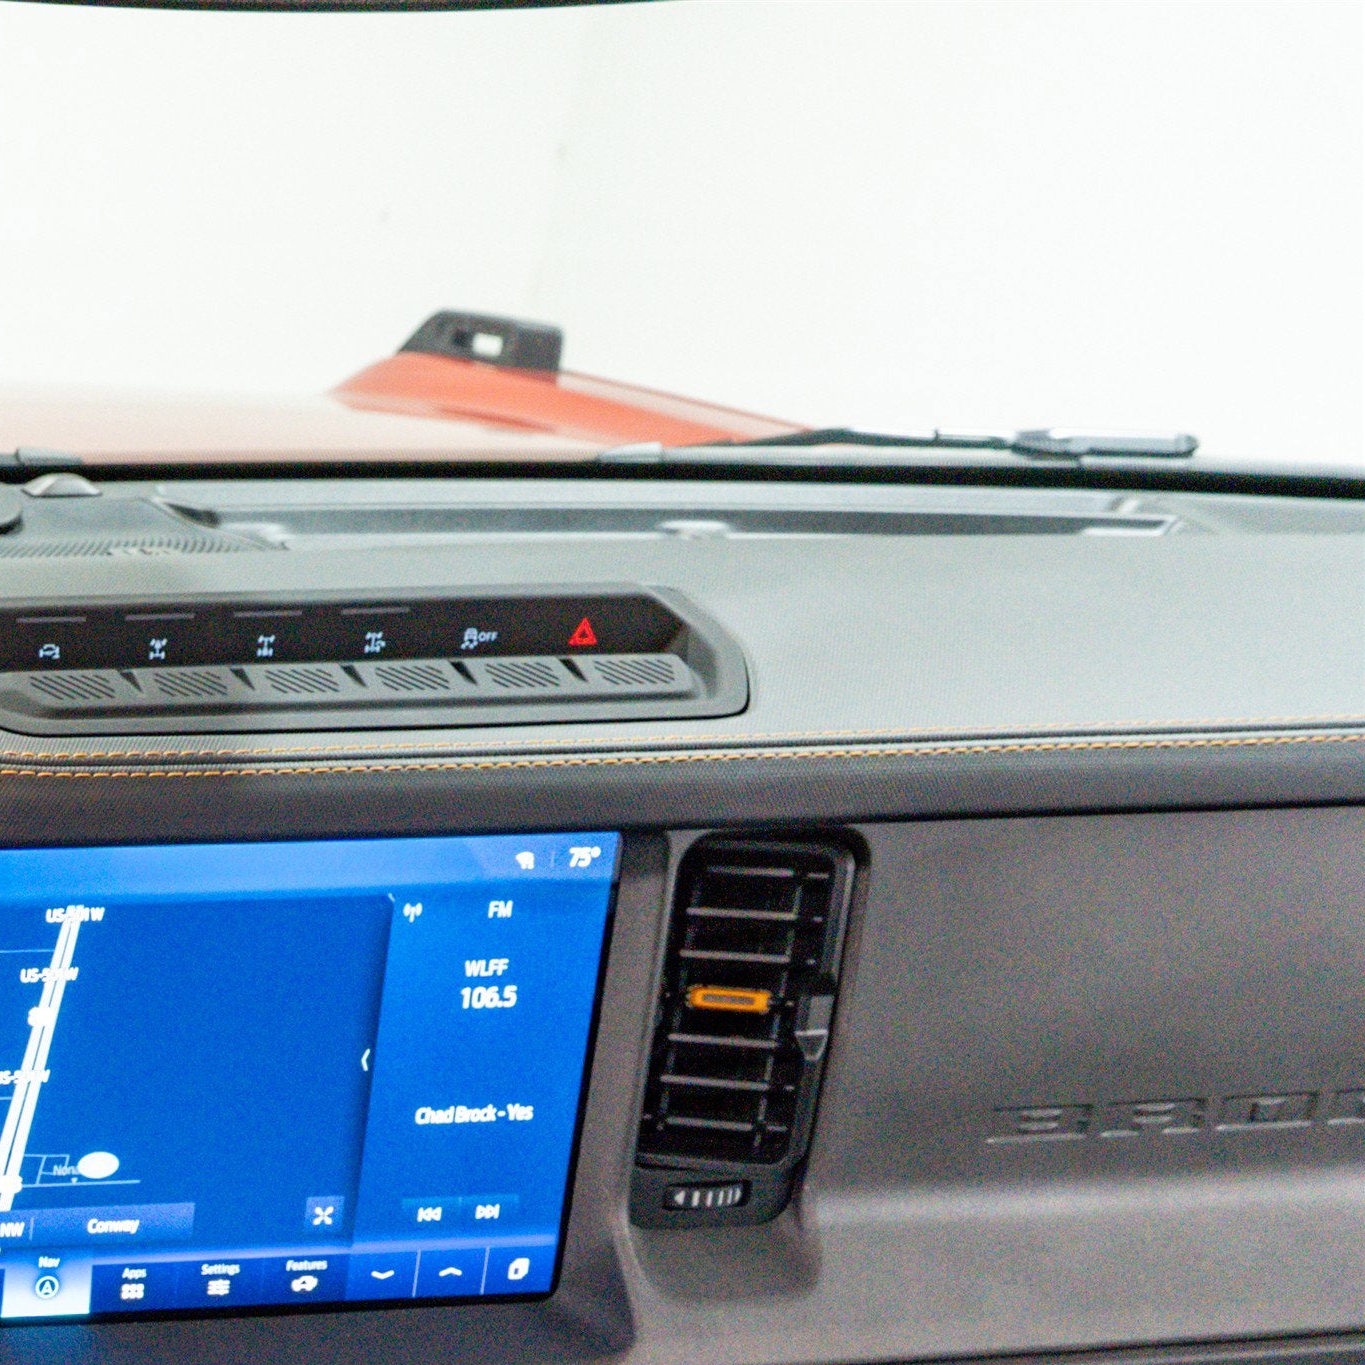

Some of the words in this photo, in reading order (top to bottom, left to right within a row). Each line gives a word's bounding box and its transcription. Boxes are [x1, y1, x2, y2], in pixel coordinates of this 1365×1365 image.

[477, 630, 498, 643] OFF
[487, 901, 514, 918] FM
[465, 958, 509, 977] WLFF
[461, 985, 518, 1009] 106.5
[415, 1106, 454, 1124] Chad
[455, 1104, 497, 1123] Brock
[507, 1103, 534, 1121] Yes
[87, 1218, 140, 1236] Conway
[38, 1256, 60, 1268] Nav
[122, 1267, 147, 1280] Apps
[201, 1263, 241, 1276] Settings
[286, 1260, 328, 1272] Features
